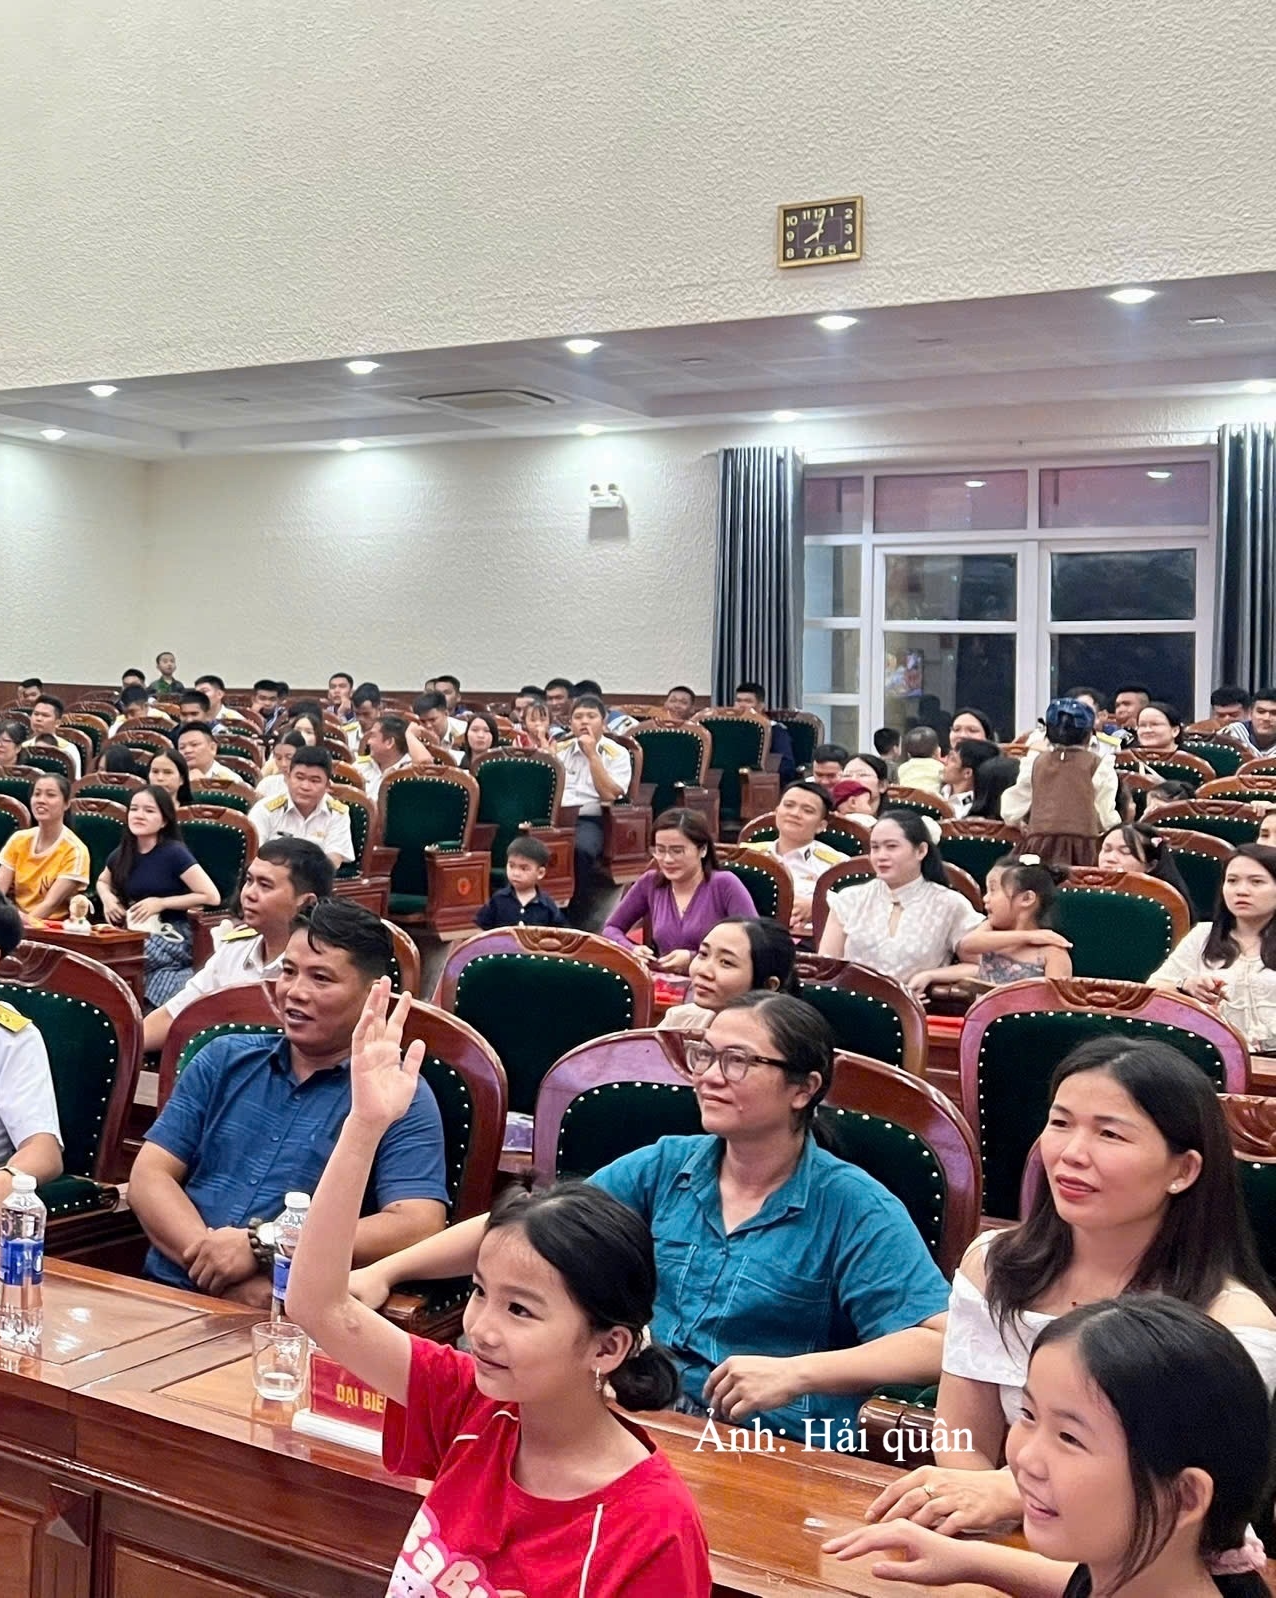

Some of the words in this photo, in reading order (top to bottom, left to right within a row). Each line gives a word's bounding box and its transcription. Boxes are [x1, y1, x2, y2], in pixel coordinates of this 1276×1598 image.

[803, 210, 810, 220] 11
[814, 207, 826, 220] 12
[830, 207, 834, 216] 1
[844, 208, 853, 219] 2
[786, 215, 798, 227] 10
[844, 223, 853, 235] 3
[786, 230, 795, 242] 9
[828, 244, 836, 255] 5
[844, 240, 853, 251] 4
[786, 247, 795, 259] 8
[804, 247, 812, 259] 7
[815, 246, 824, 257] 6
